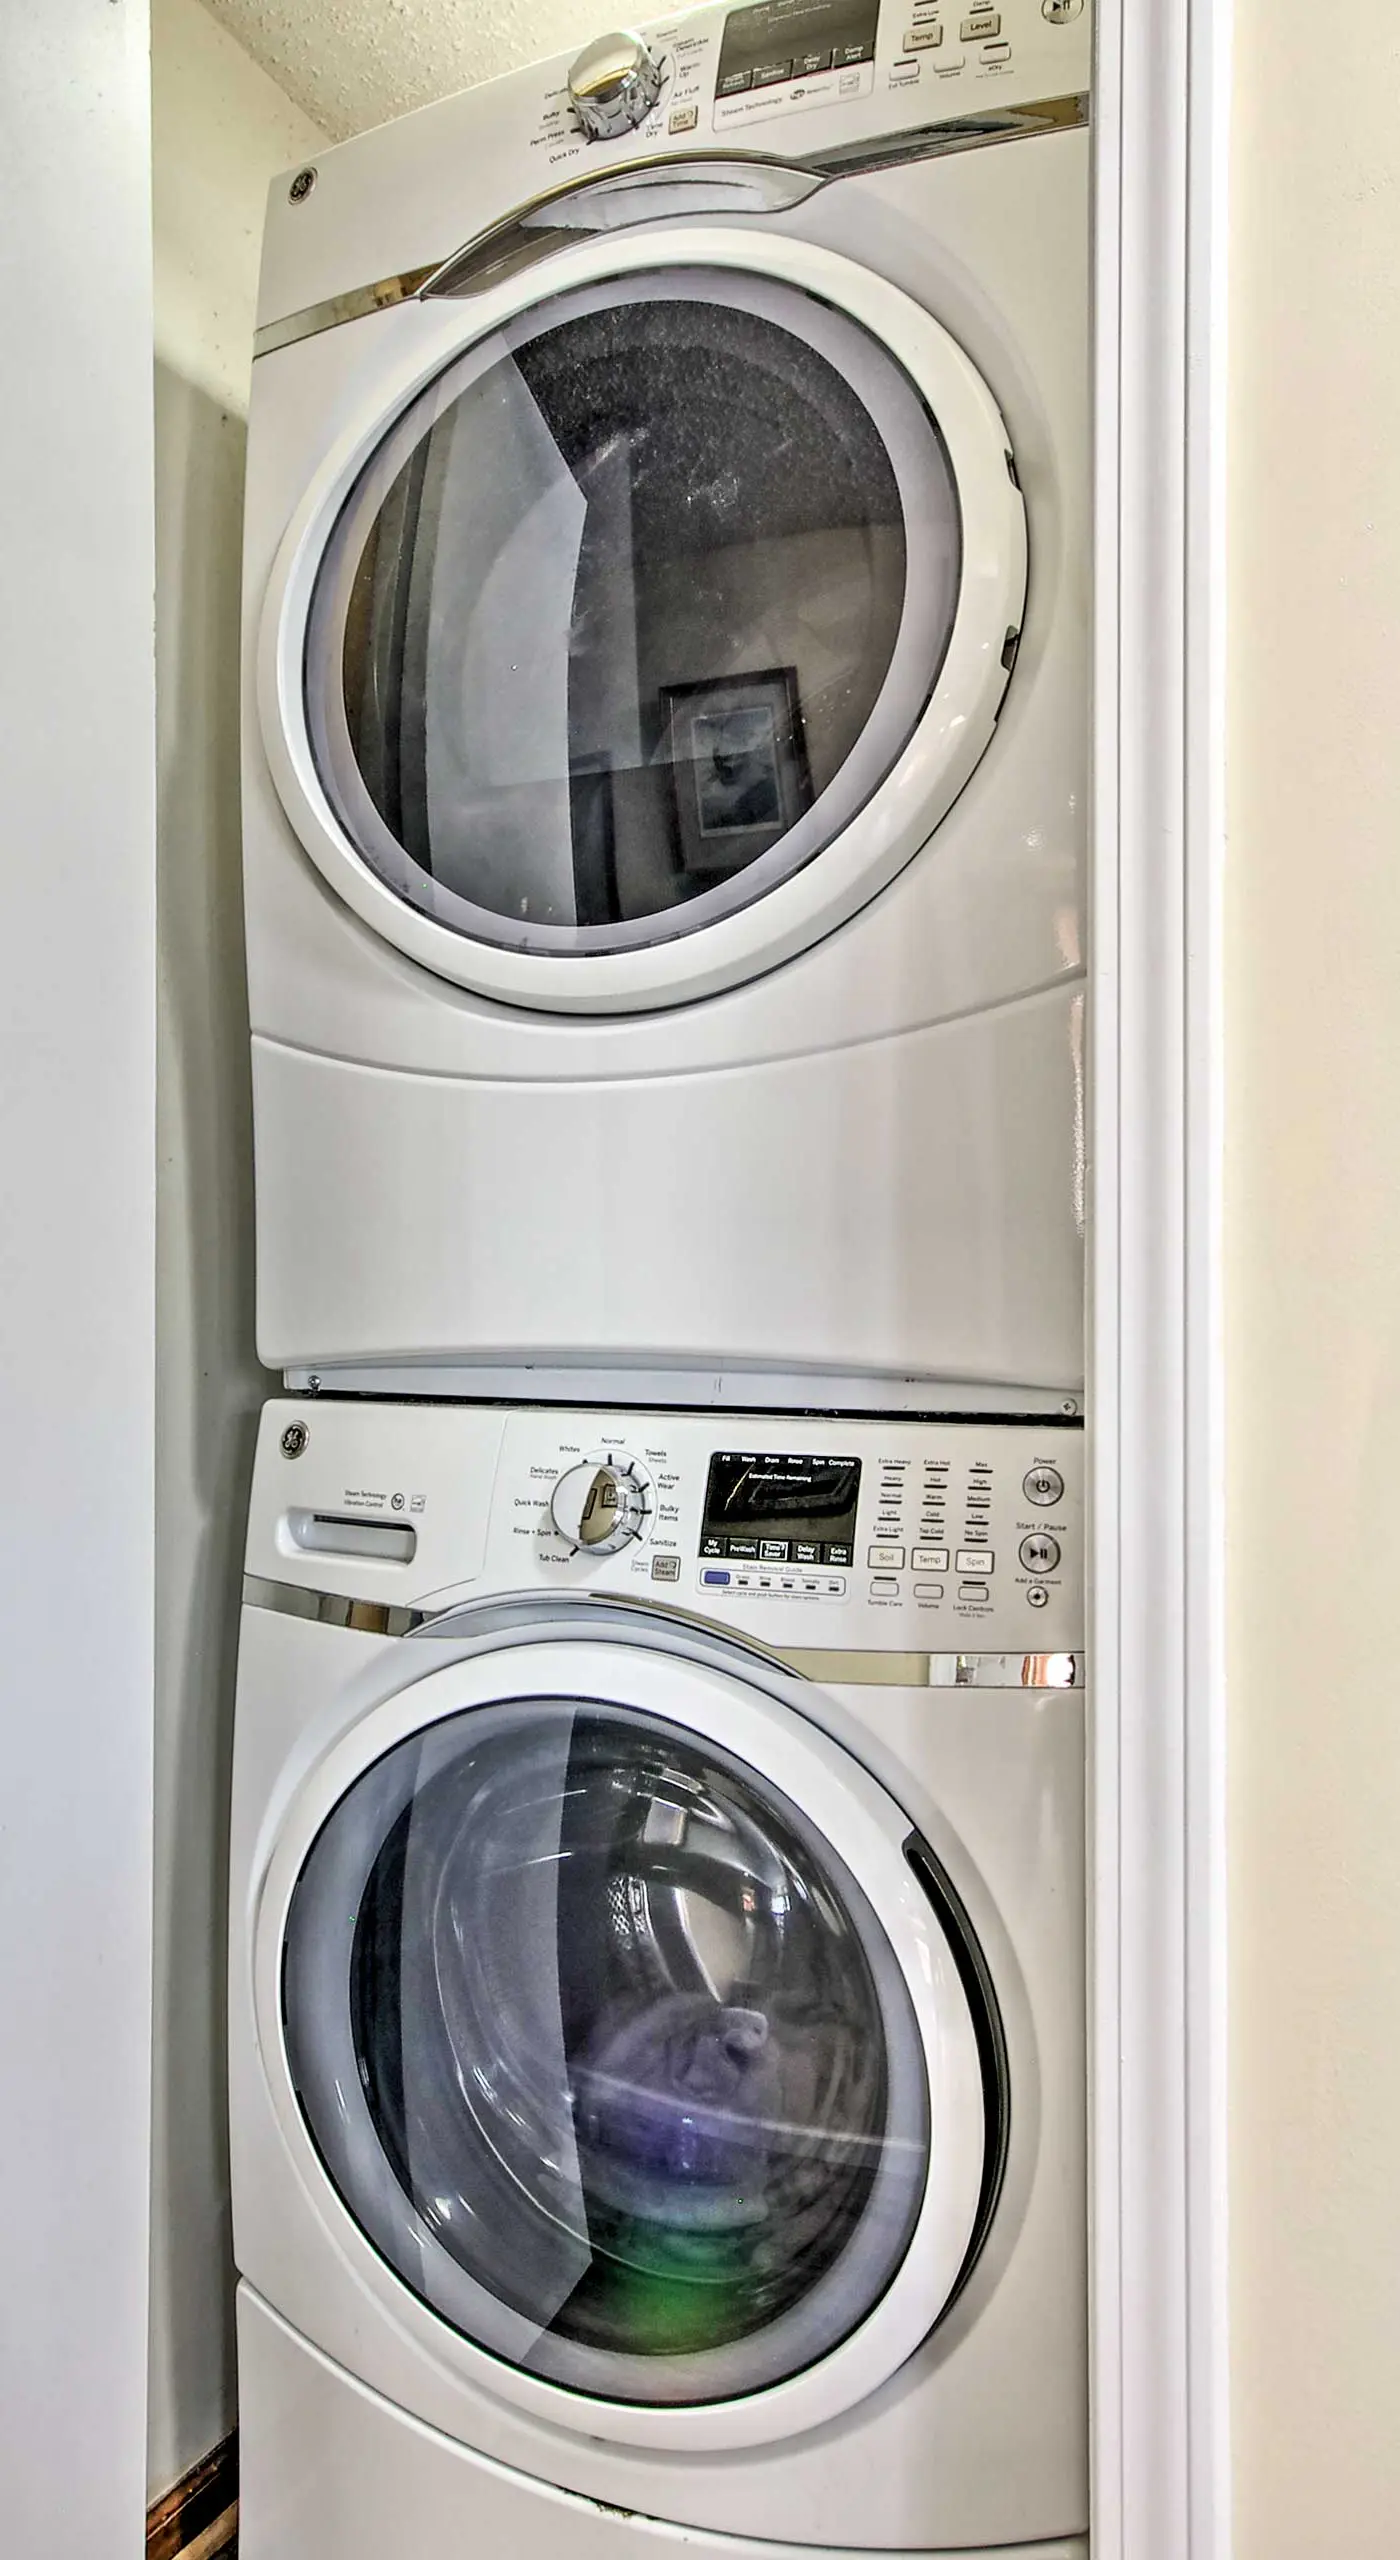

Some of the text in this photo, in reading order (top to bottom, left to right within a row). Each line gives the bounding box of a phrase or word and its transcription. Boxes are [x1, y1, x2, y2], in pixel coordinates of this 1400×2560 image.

[970, 20, 992, 31] Level
[911, 32, 934, 42] Temp
[568, 148, 580, 156] Dry
[646, 1449, 667, 1457] Towels
[828, 1459, 855, 1467] Complete
[1033, 1457, 1057, 1465] Power
[530, 1466, 558, 1475] Delicates
[659, 1473, 680, 1481] Active
[749, 1472, 773, 1480] Estimated
[514, 1498, 549, 1507] Quick Wash
[659, 1504, 679, 1515] Bulky
[659, 1514, 678, 1522] Items
[1016, 1522, 1035, 1530] Start
[1044, 1524, 1067, 1532] Pause
[513, 1527, 530, 1535] Rinse
[537, 1528, 551, 1537] Spin
[650, 1538, 677, 1547] Sanitize
[765, 1543, 778, 1551] Time
[704, 1546, 721, 1555] Cycle
[797, 1545, 815, 1554] Delay
[830, 1548, 847, 1556] Extra
[539, 1553, 570, 1563] Tub Clean
[879, 1553, 894, 1561] Soil
[919, 1555, 941, 1564] Temp
[966, 1556, 985, 1567] Spin
[655, 1567, 676, 1576] Steam
[760, 1564, 784, 1572] Removal
